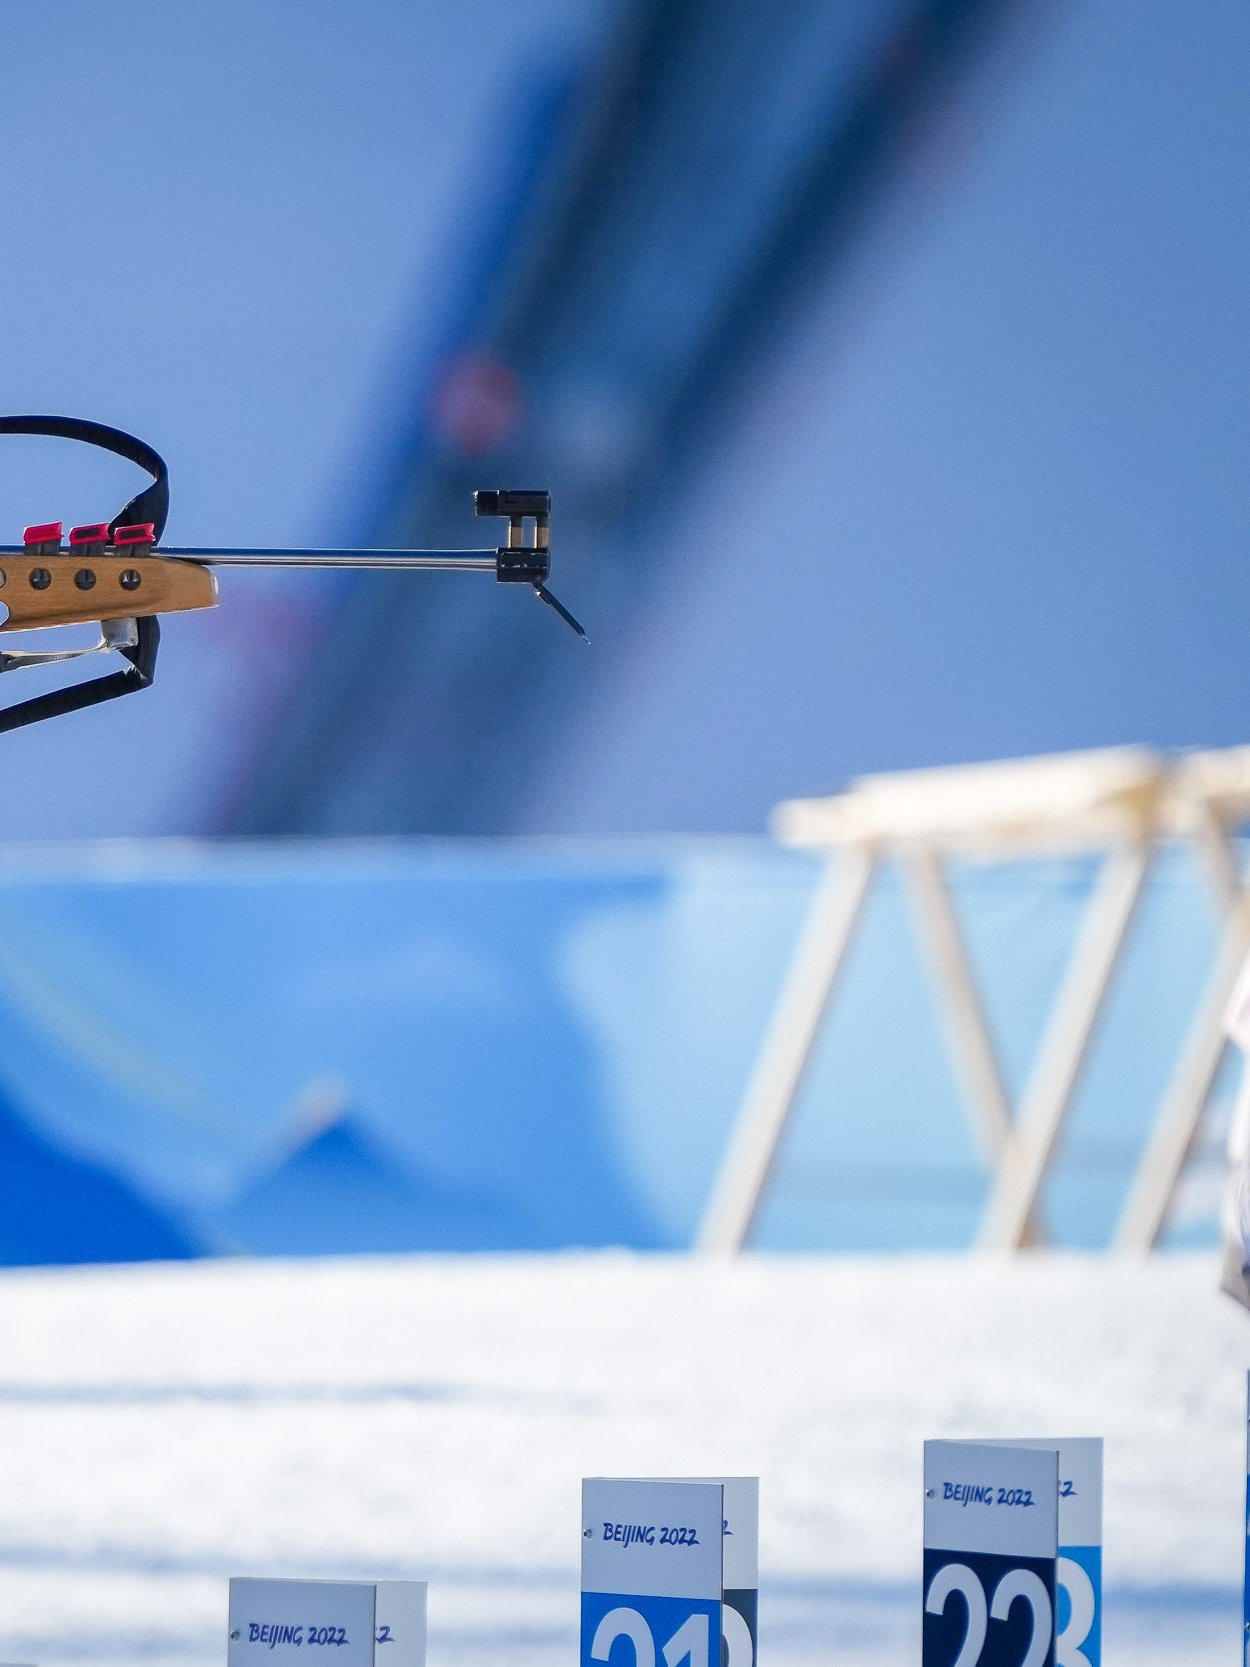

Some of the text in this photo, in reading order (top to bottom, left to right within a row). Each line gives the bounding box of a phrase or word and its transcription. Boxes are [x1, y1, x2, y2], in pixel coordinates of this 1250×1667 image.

[942, 1481, 1036, 1508] BEIJING 2022
[602, 1522, 656, 1549] BEIJING
[659, 1527, 701, 1547] 2022
[248, 1622, 350, 1650] BEIJING 2022
